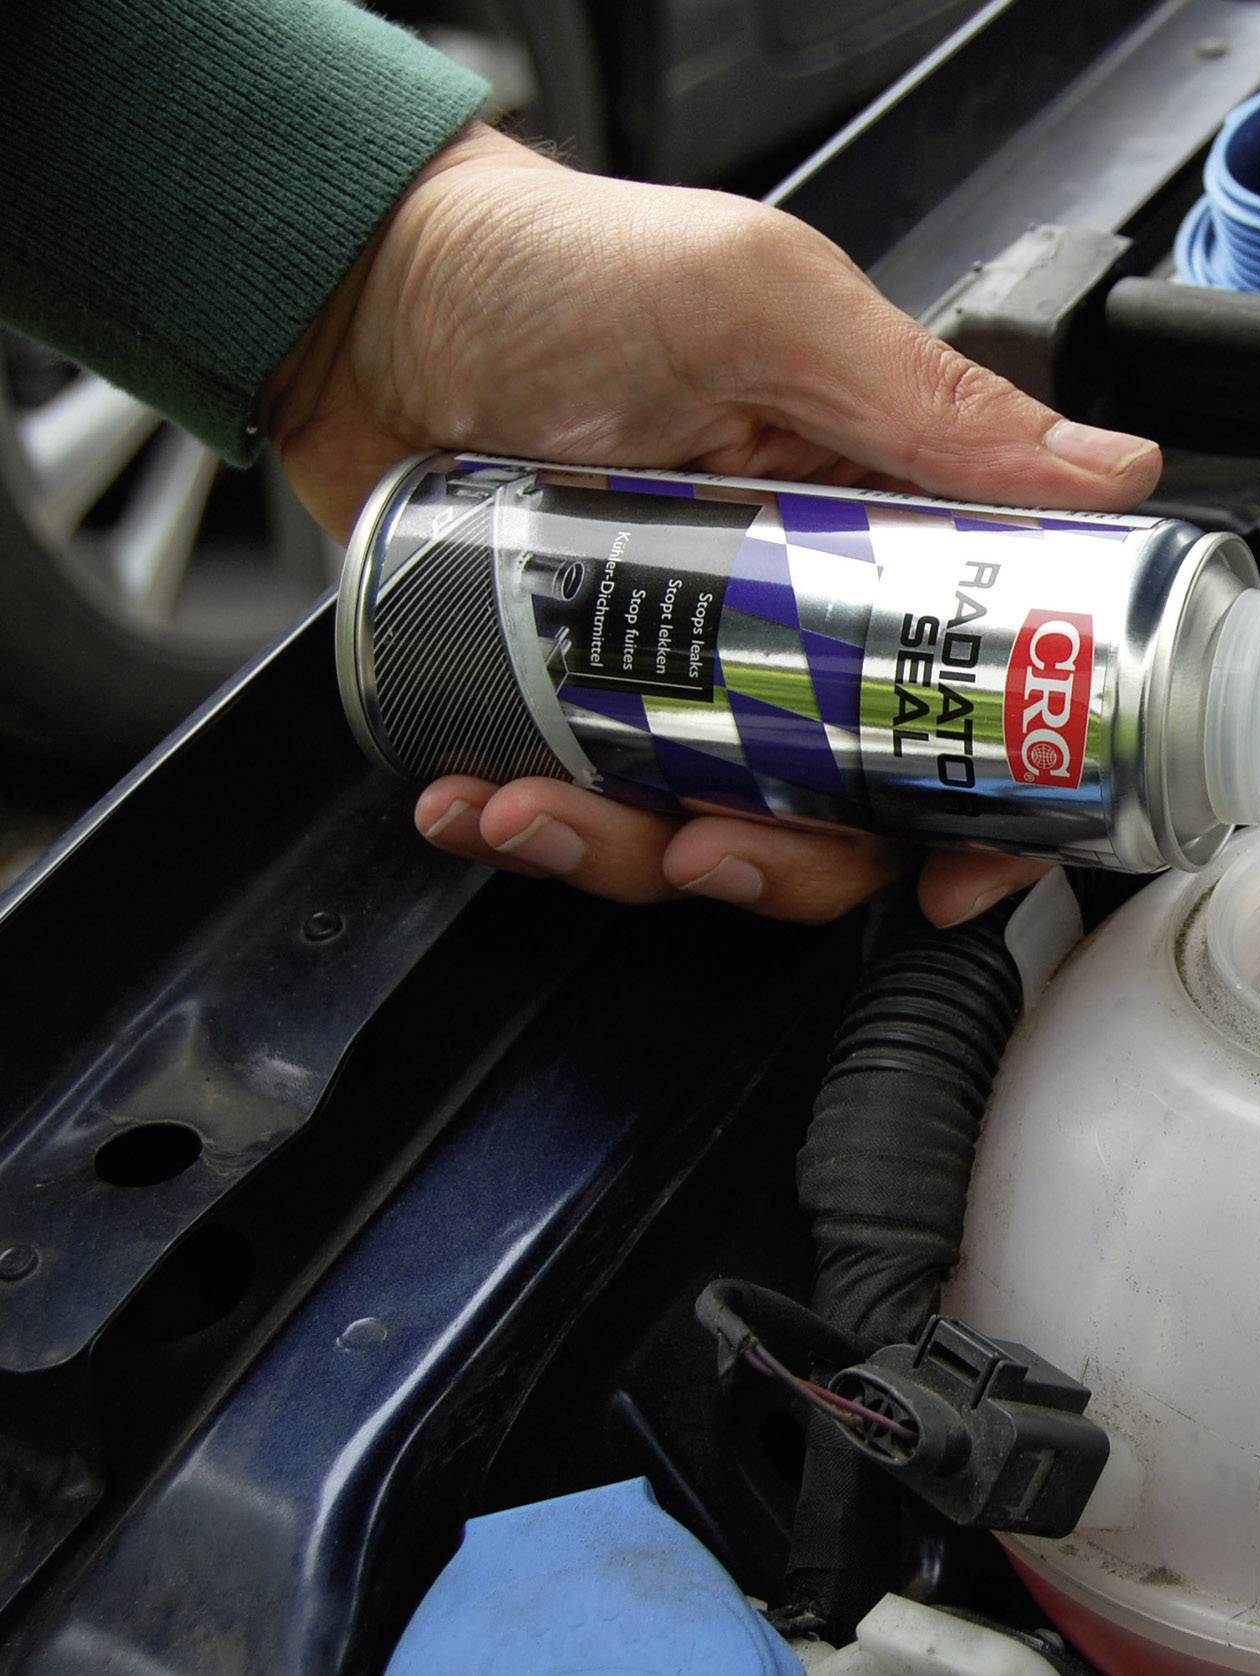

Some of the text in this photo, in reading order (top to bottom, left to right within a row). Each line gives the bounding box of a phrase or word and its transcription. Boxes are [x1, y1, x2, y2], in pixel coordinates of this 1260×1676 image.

[589, 531, 632, 668] Kühler-Dichtmittel
[622, 589, 646, 671] Stop fuites
[655, 578, 683, 675] Stopt lekken
[688, 592, 713, 679] Stops leaks
[892, 612, 940, 758] SEAL
[936, 560, 1002, 818] RADIATOR
